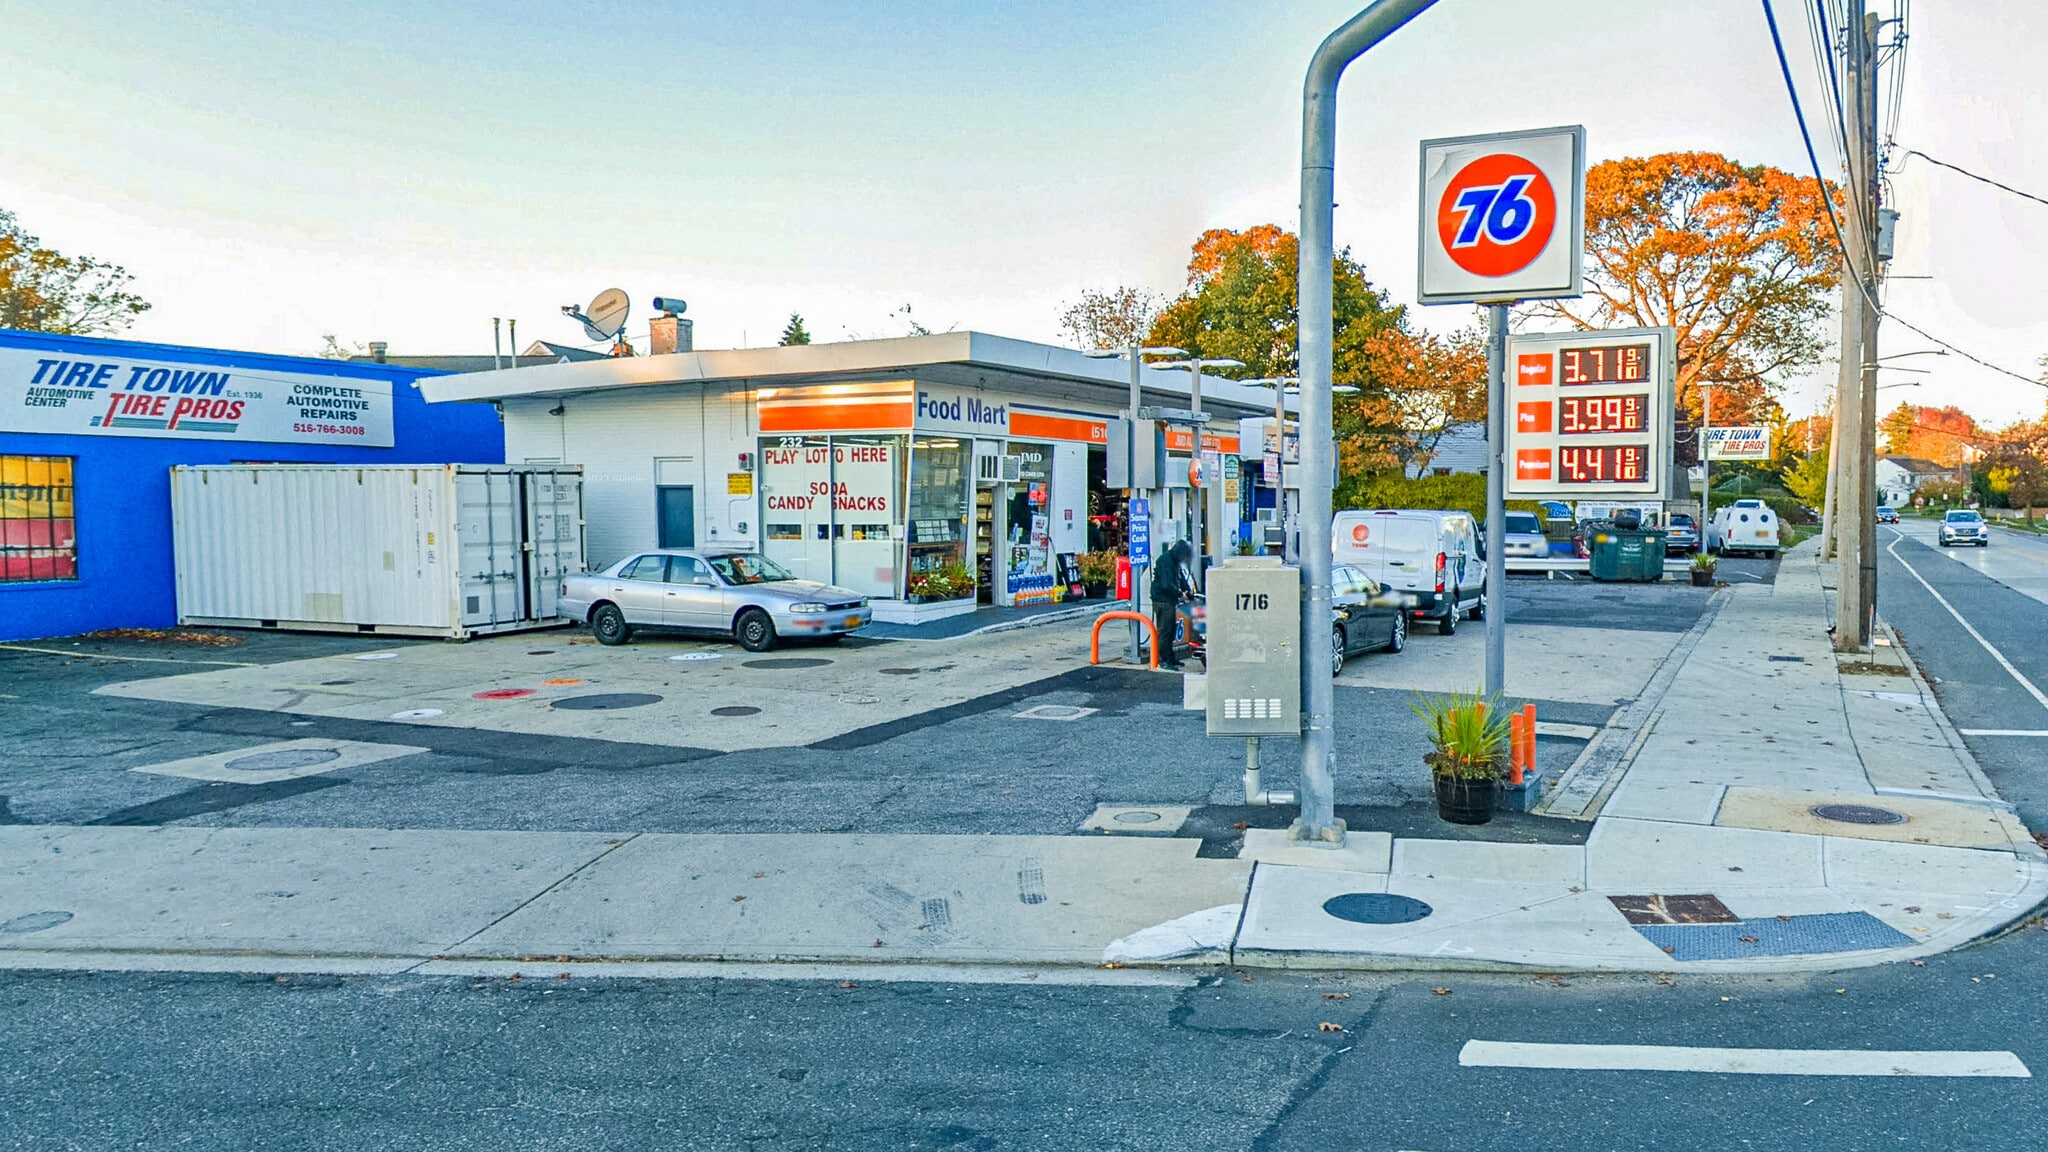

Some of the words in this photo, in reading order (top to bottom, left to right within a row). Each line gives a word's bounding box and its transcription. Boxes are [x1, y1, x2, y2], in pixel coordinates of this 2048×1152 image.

[1451, 174, 1537, 249] 76
[1520, 364, 1547, 375] Regular
[1564, 349, 1624, 382] 3.71
[31, 359, 119, 389] TIRE
[125, 366, 230, 396] TOWN
[26, 387, 95, 400] AUTOMOTIVE
[226, 390, 242, 398] Est.
[245, 391, 263, 399] 1936
[293, 385, 362, 398] COMPLETE
[25, 397, 67, 408] CENTER
[286, 396, 369, 410] AUTOMOTIVE
[918, 391, 961, 421] Food
[967, 397, 1006, 425] Mart
[102, 393, 170, 427] TIRE
[168, 397, 245, 429] PROS
[300, 409, 357, 421] REPAIRS
[1520, 412, 1535, 422] Plus
[1563, 399, 1621, 431] 3.99
[293, 423, 365, 435] 516-766-3008
[1091, 425, 1108, 440] (51
[1729, 429, 1762, 440] TOWN
[780, 437, 802, 448] 232
[1722, 441, 1742, 455] TIRE
[1741, 441, 1766, 455] PROS
[765, 450, 798, 464] PLAY
[851, 447, 888, 462] HERE
[1020, 452, 1042, 465] JMD
[1519, 460, 1551, 469] Premium
[1562, 449, 1621, 480] 4.41
[810, 482, 848, 496] SODA
[768, 496, 814, 510] CANDY
[831, 496, 886, 511] SNACKS
[1130, 513, 1148, 521] Same
[1132, 523, 1147, 532] Price
[1132, 533, 1147, 543] Cash
[1130, 554, 1148, 564] Credit
[1236, 594, 1269, 610] 1716
